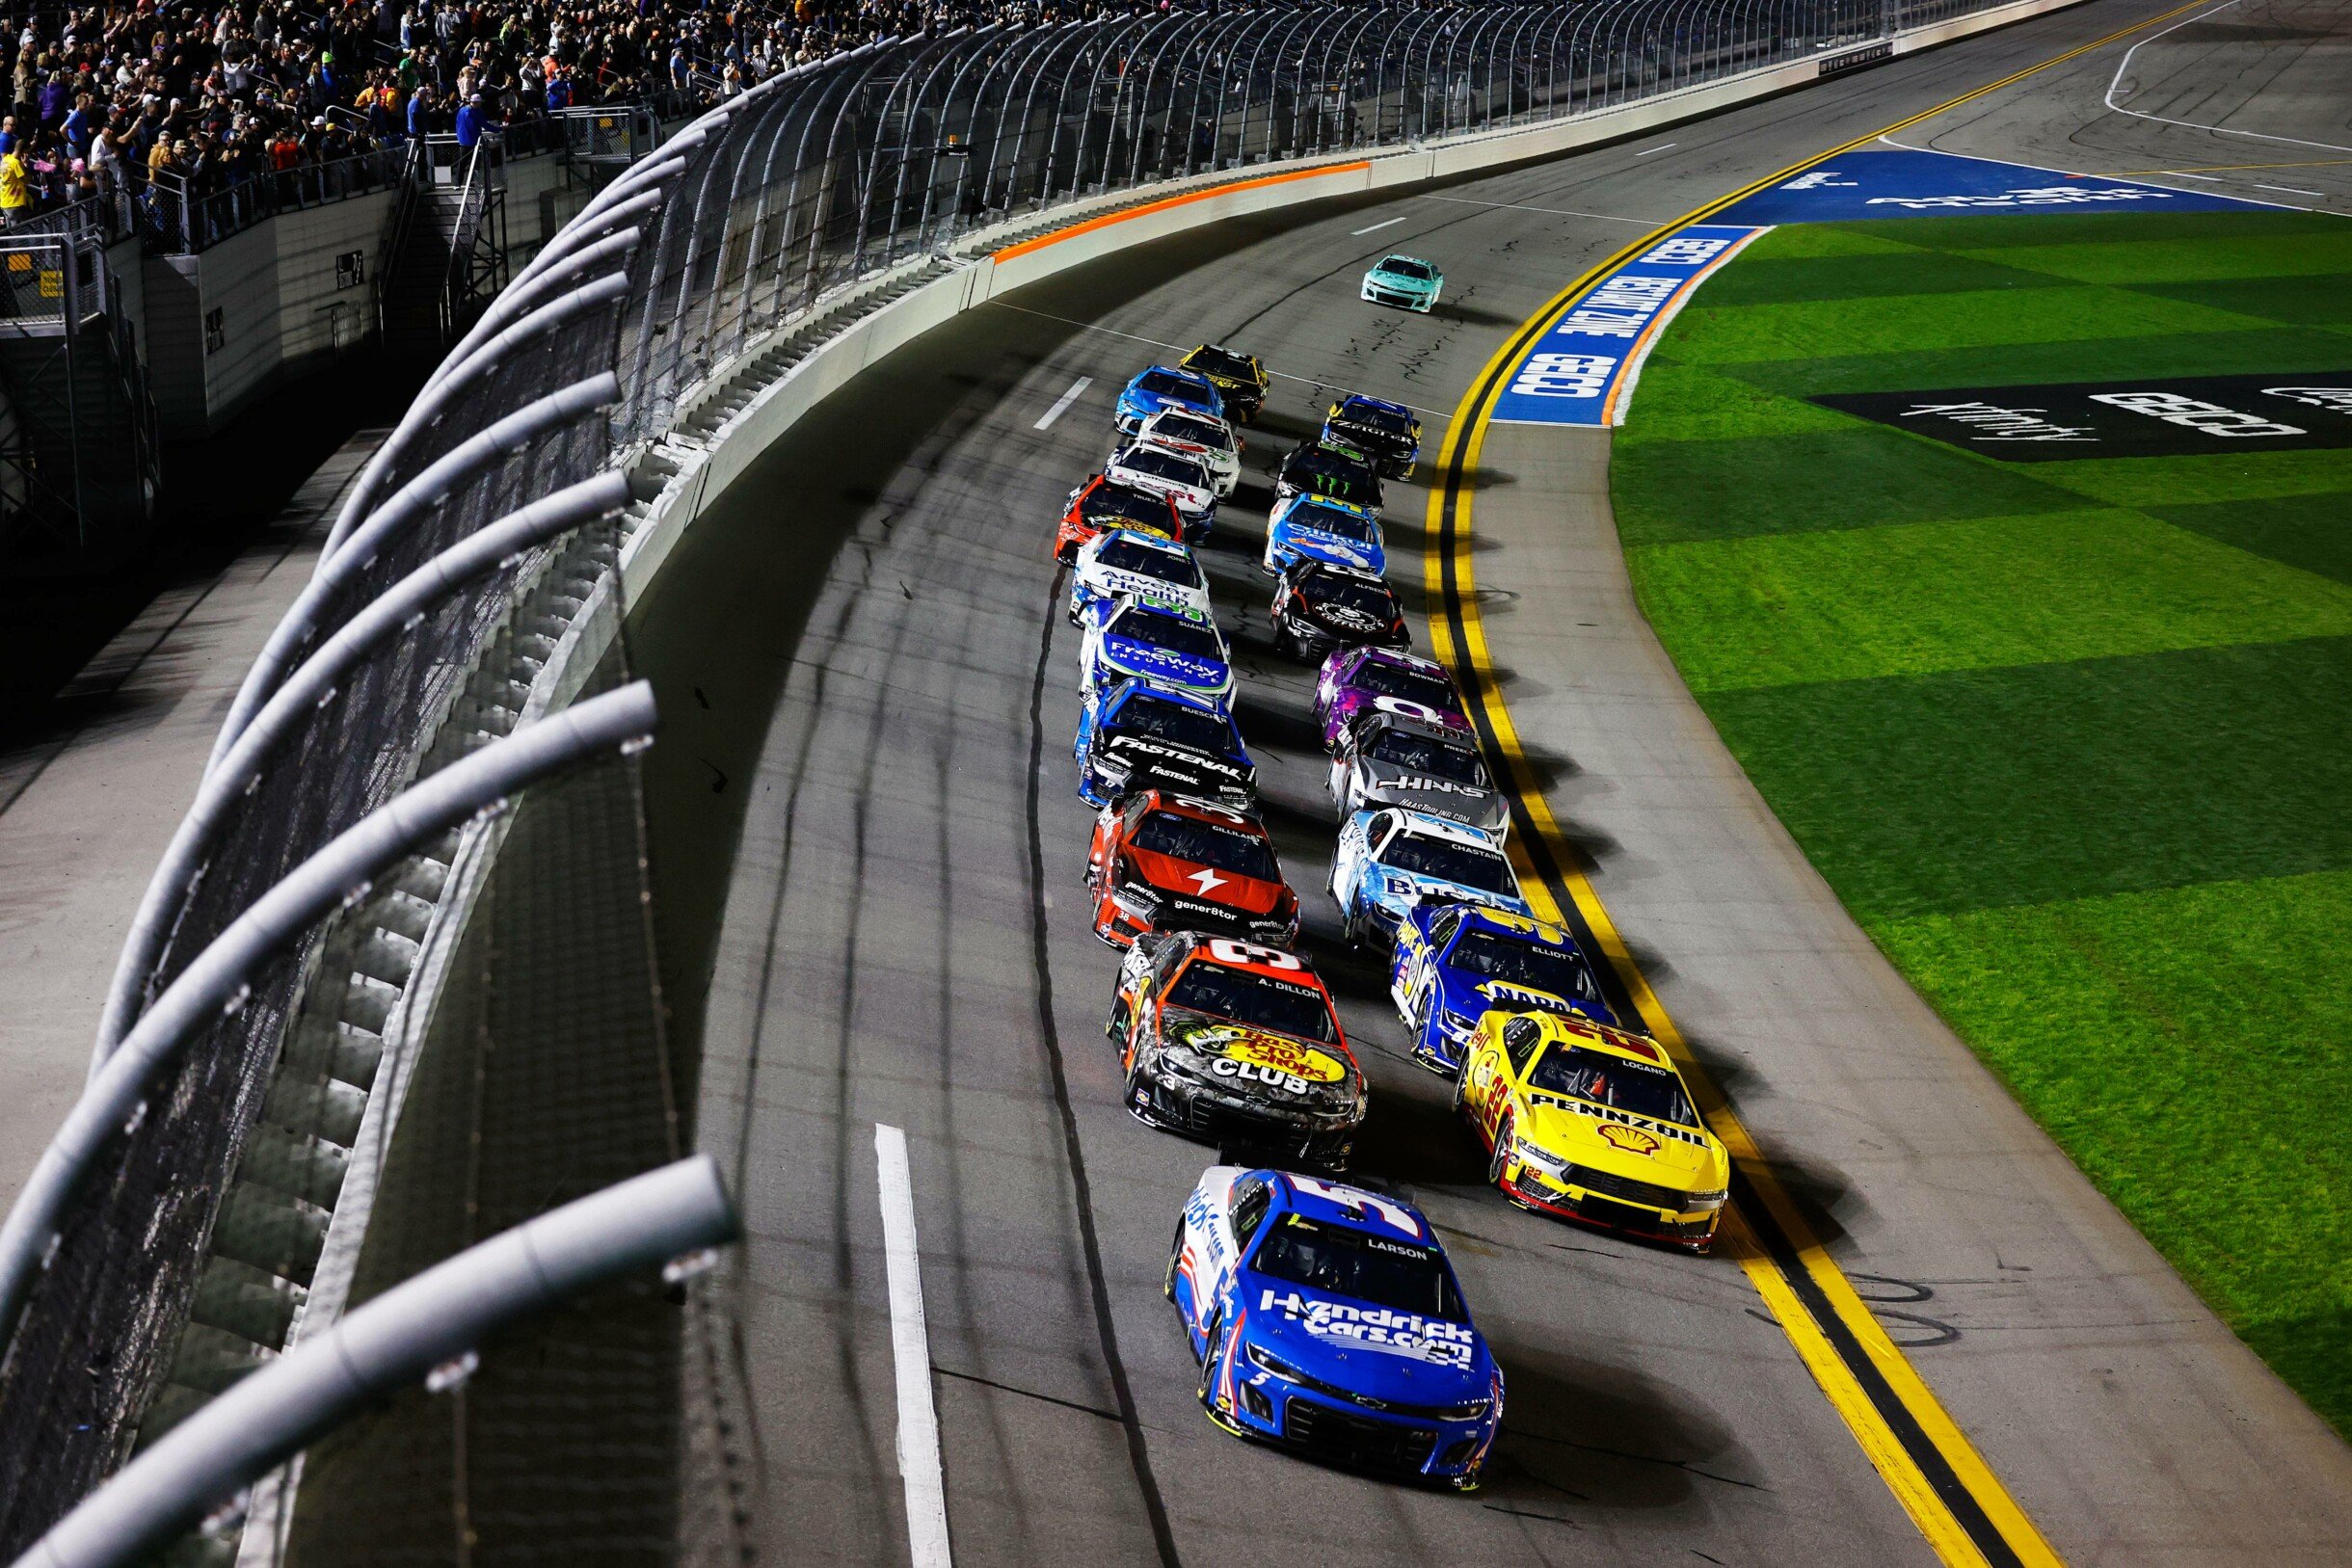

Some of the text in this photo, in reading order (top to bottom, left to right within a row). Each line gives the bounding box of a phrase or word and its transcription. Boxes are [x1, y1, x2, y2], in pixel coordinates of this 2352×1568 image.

[1639, 238, 1731, 265] GEICO
[1557, 276, 1684, 338] RESTART ZONE
[1510, 353, 1617, 399] GEICO
[2088, 392, 2309, 438] GEICO
[1110, 642, 1219, 677] Freeway
[1139, 669, 1188, 685] Freeway.com
[1408, 671, 1445, 685] BOWMAN
[1109, 735, 1242, 782] FASTENAL
[1149, 765, 1200, 785] FASTENAL
[1451, 843, 1502, 862] CHASTAIN
[1124, 880, 1163, 905] gener8tor
[1118, 910, 1130, 921] 38
[1174, 899, 1238, 921] gener8tor
[1249, 919, 1285, 931] gener8tor
[1209, 939, 1302, 970] 3
[1532, 945, 1574, 962] ELLIOTT
[1258, 977, 1321, 1000] A. DILLON
[1494, 985, 1568, 1012] NAPA
[1243, 1029, 1306, 1056] Bass
[1246, 1040, 1296, 1060] Pro
[1211, 1057, 1309, 1095] CLUB
[1246, 1049, 1328, 1081] Shops
[1622, 1059, 1667, 1076] LOGANO
[1162, 1076, 1176, 1091] 3
[1530, 1093, 1711, 1150] PENNZOIL
[1525, 1165, 1542, 1180] 22
[1368, 1238, 1428, 1262] LARSON
[1259, 1289, 1473, 1345] Hendrick
[1303, 1316, 1473, 1369] Cars.com
[1249, 1371, 1271, 1386] 5
